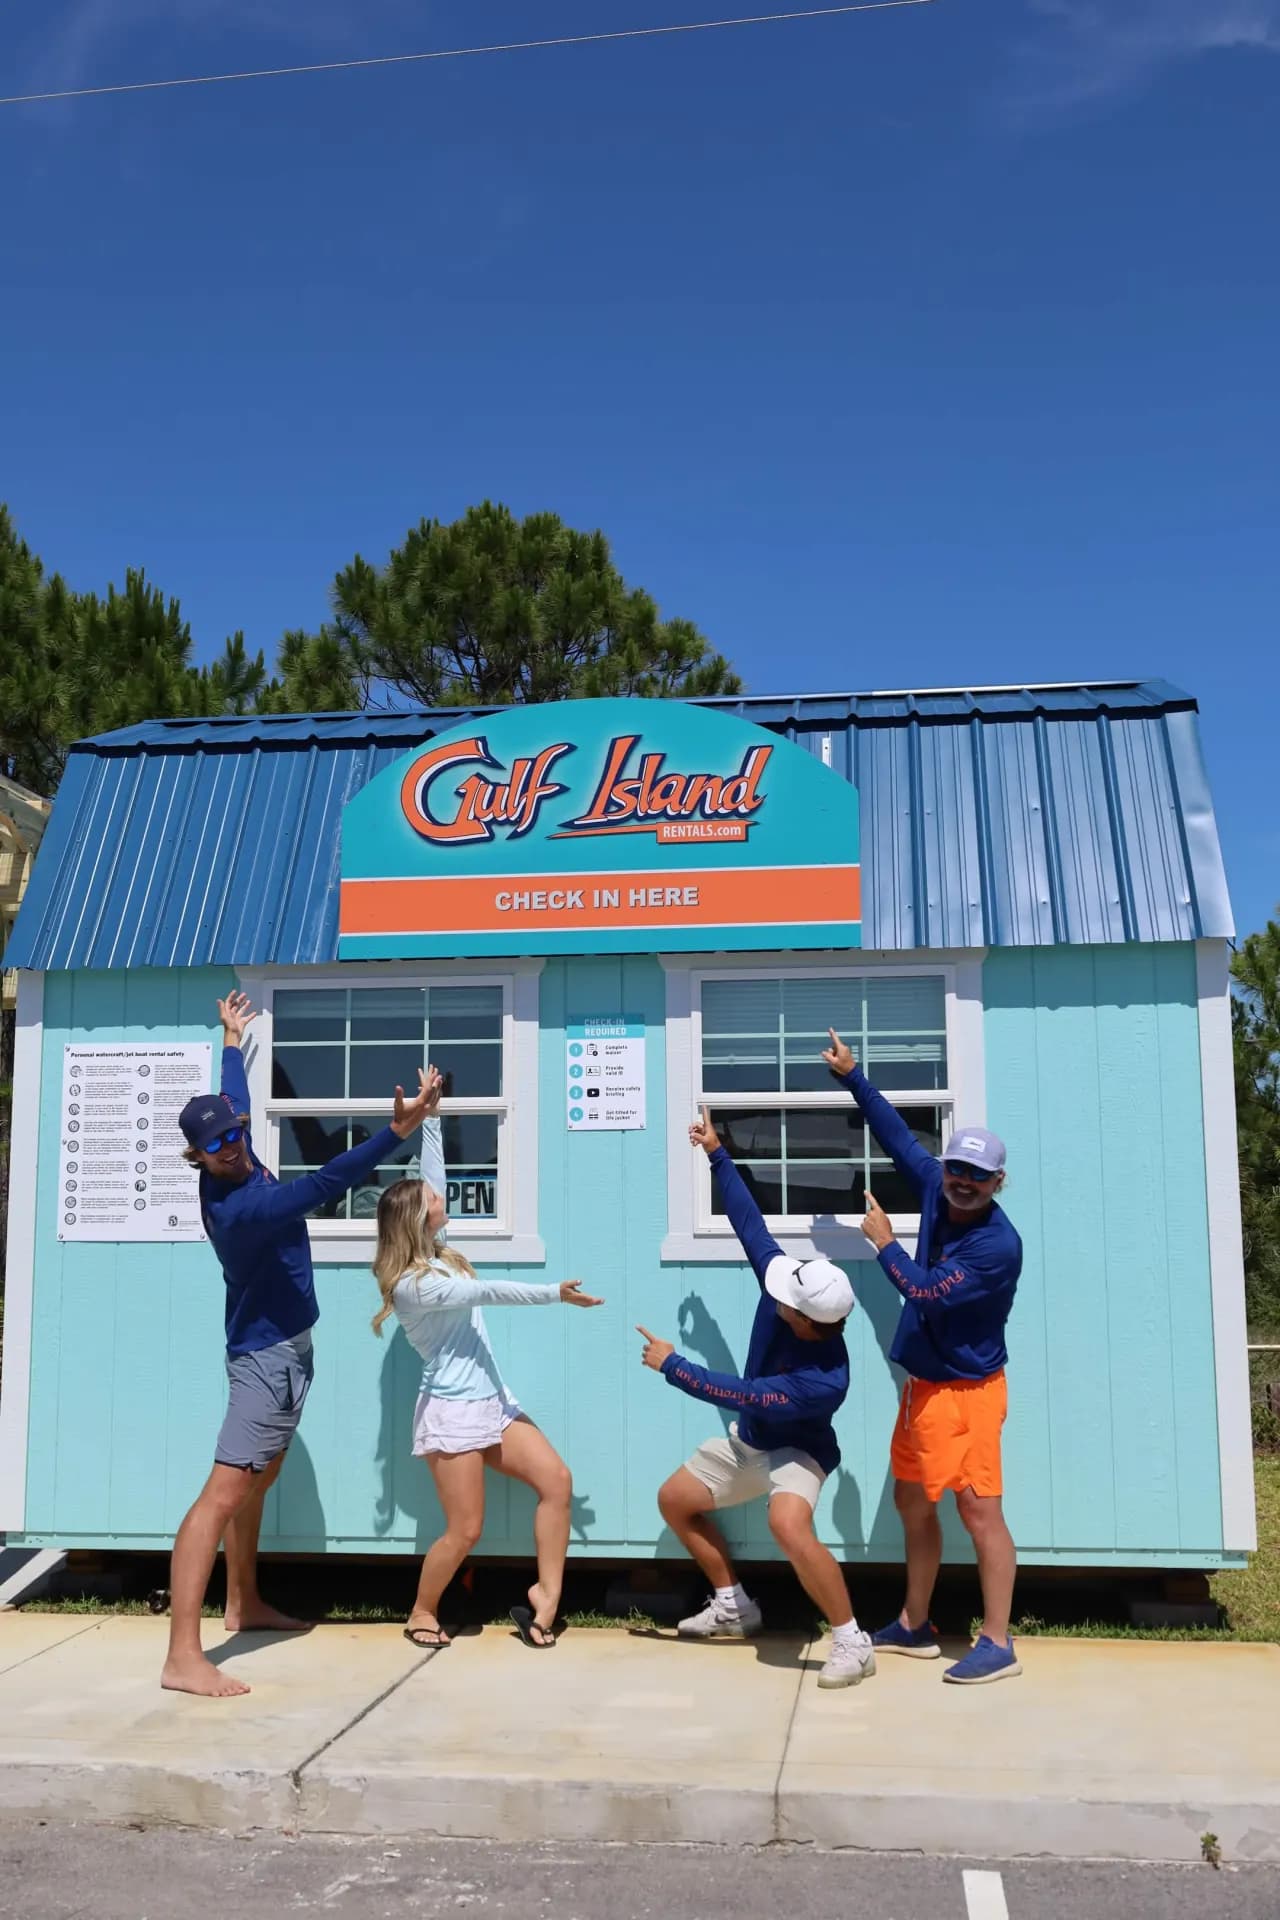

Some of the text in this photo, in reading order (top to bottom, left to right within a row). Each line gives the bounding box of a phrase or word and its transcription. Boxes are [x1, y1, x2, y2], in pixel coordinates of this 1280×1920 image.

[400, 734, 774, 845] Gulf Island
[663, 824, 742, 838] RENTALS.com
[495, 887, 699, 911] CHECK IN HERE
[584, 1018, 625, 1026] CHECK-IN
[584, 1027, 627, 1036] REQUIRED
[446, 1181, 494, 1214] PEN
[940, 1269, 965, 1295] Full
[704, 1383, 759, 1405] Throttle
[761, 1393, 789, 1407] Full
